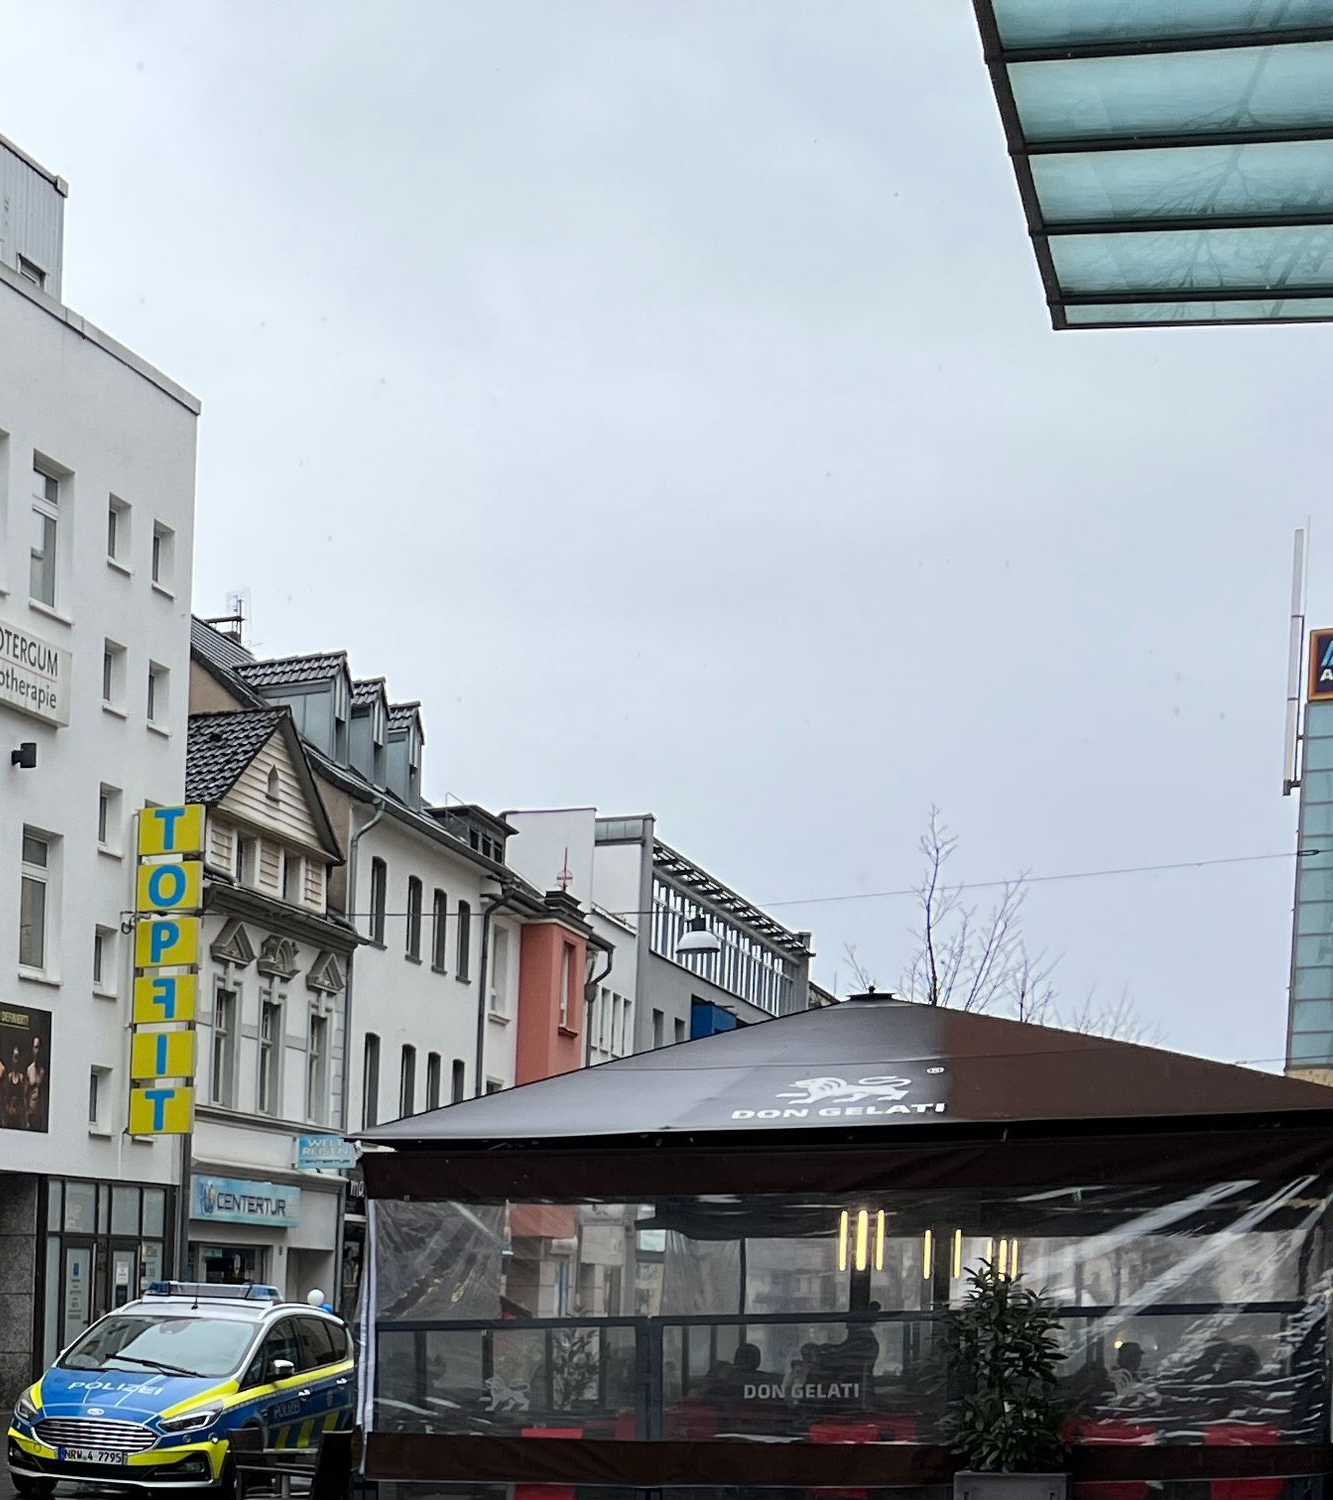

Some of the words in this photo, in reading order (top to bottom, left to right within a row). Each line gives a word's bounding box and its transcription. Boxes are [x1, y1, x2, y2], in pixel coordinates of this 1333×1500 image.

[731, 1108, 809, 1120] DON
[818, 1102, 946, 1117] GELATI
[216, 1191, 287, 1217] CENTERTUR
[68, 1381, 163, 1397] POLIZEI
[743, 1384, 786, 1399] DON
[791, 1383, 860, 1399] GELATI
[87, 1450, 94, 1462] 4
[98, 1450, 122, 1463] 7795
